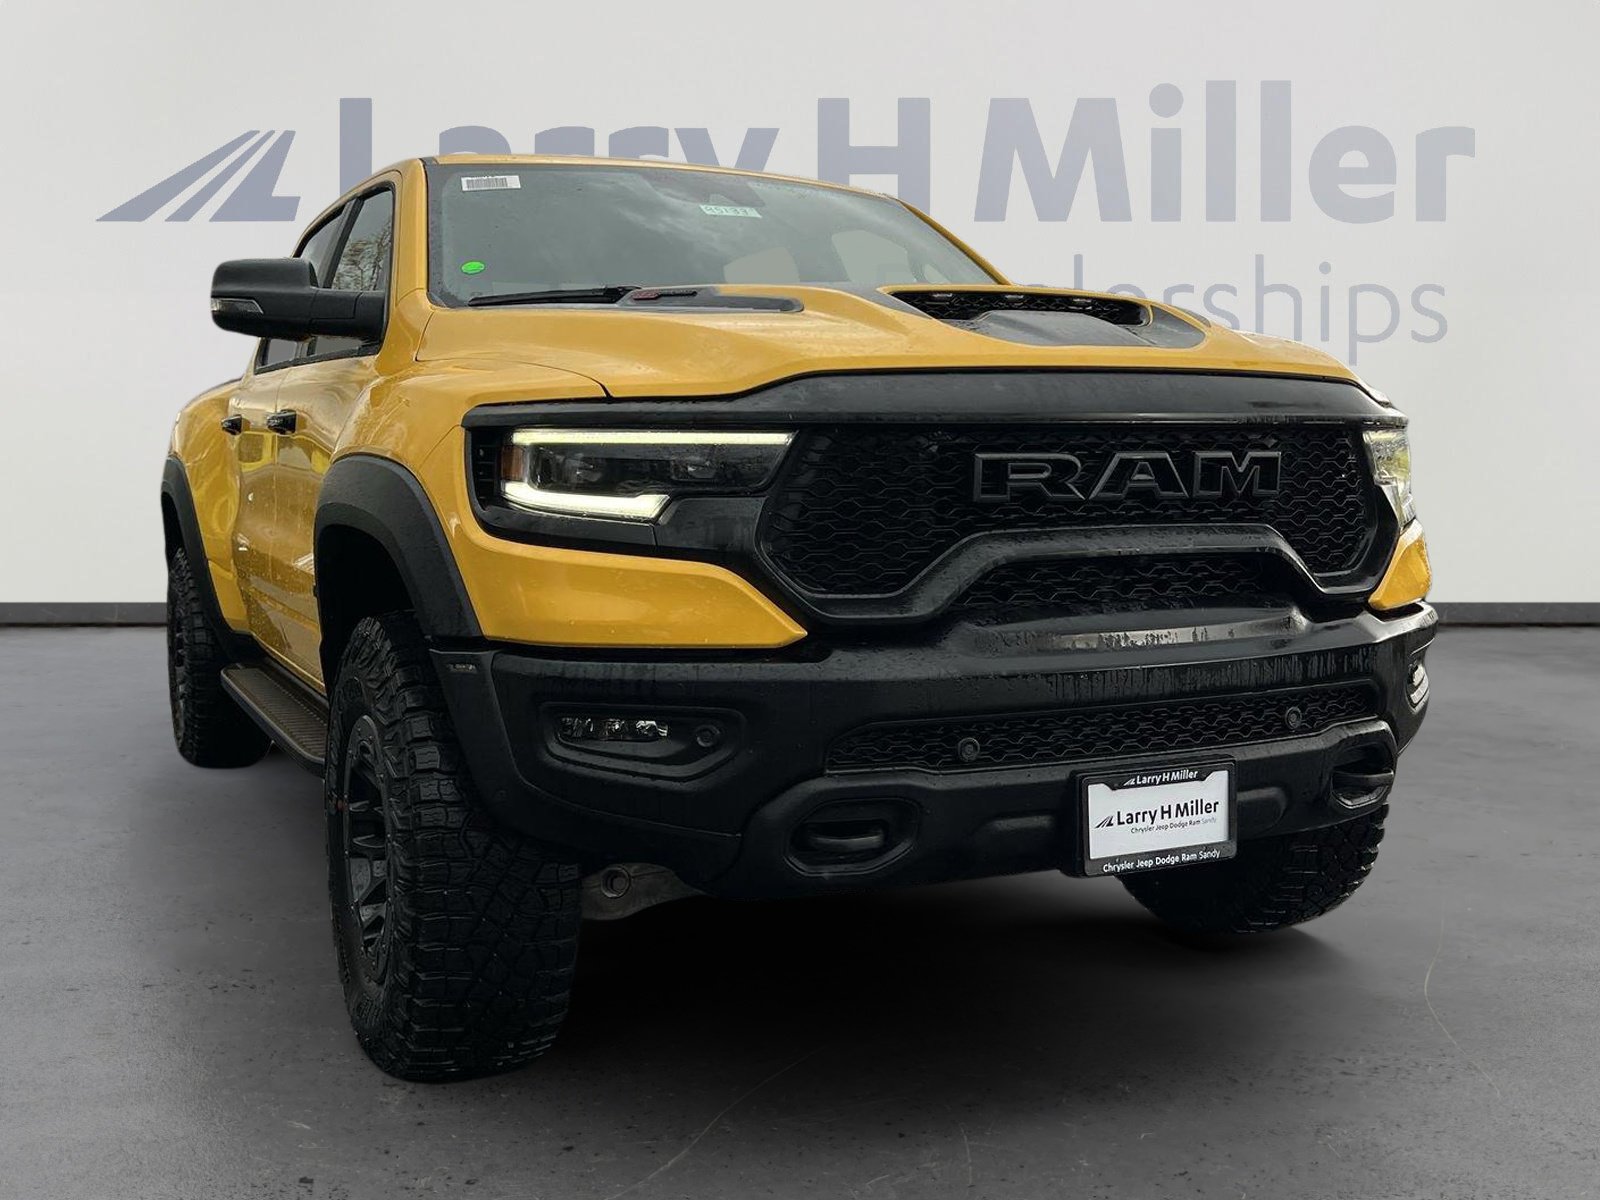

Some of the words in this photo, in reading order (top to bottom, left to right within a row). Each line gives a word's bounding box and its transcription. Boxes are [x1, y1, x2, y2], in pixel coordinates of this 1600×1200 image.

[974, 80, 1476, 223] Miller
[972, 450, 1282, 503] RAM
[1136, 774, 1162, 785] Larry
[1162, 772, 1170, 782] H
[1171, 769, 1198, 781] Miller
[1117, 810, 1157, 826] Larry
[1160, 804, 1172, 820] H
[1175, 798, 1219, 819] Miller
[1130, 824, 1155, 834] Chrysler
[1169, 819, 1189, 830] Dodge
[1103, 860, 1135, 873] Chrysler
[1136, 858, 1153, 870] Jeep
[1155, 855, 1180, 867] Dodge
[1181, 852, 1197, 862] Ram
[1199, 848, 1221, 862] Sandy
